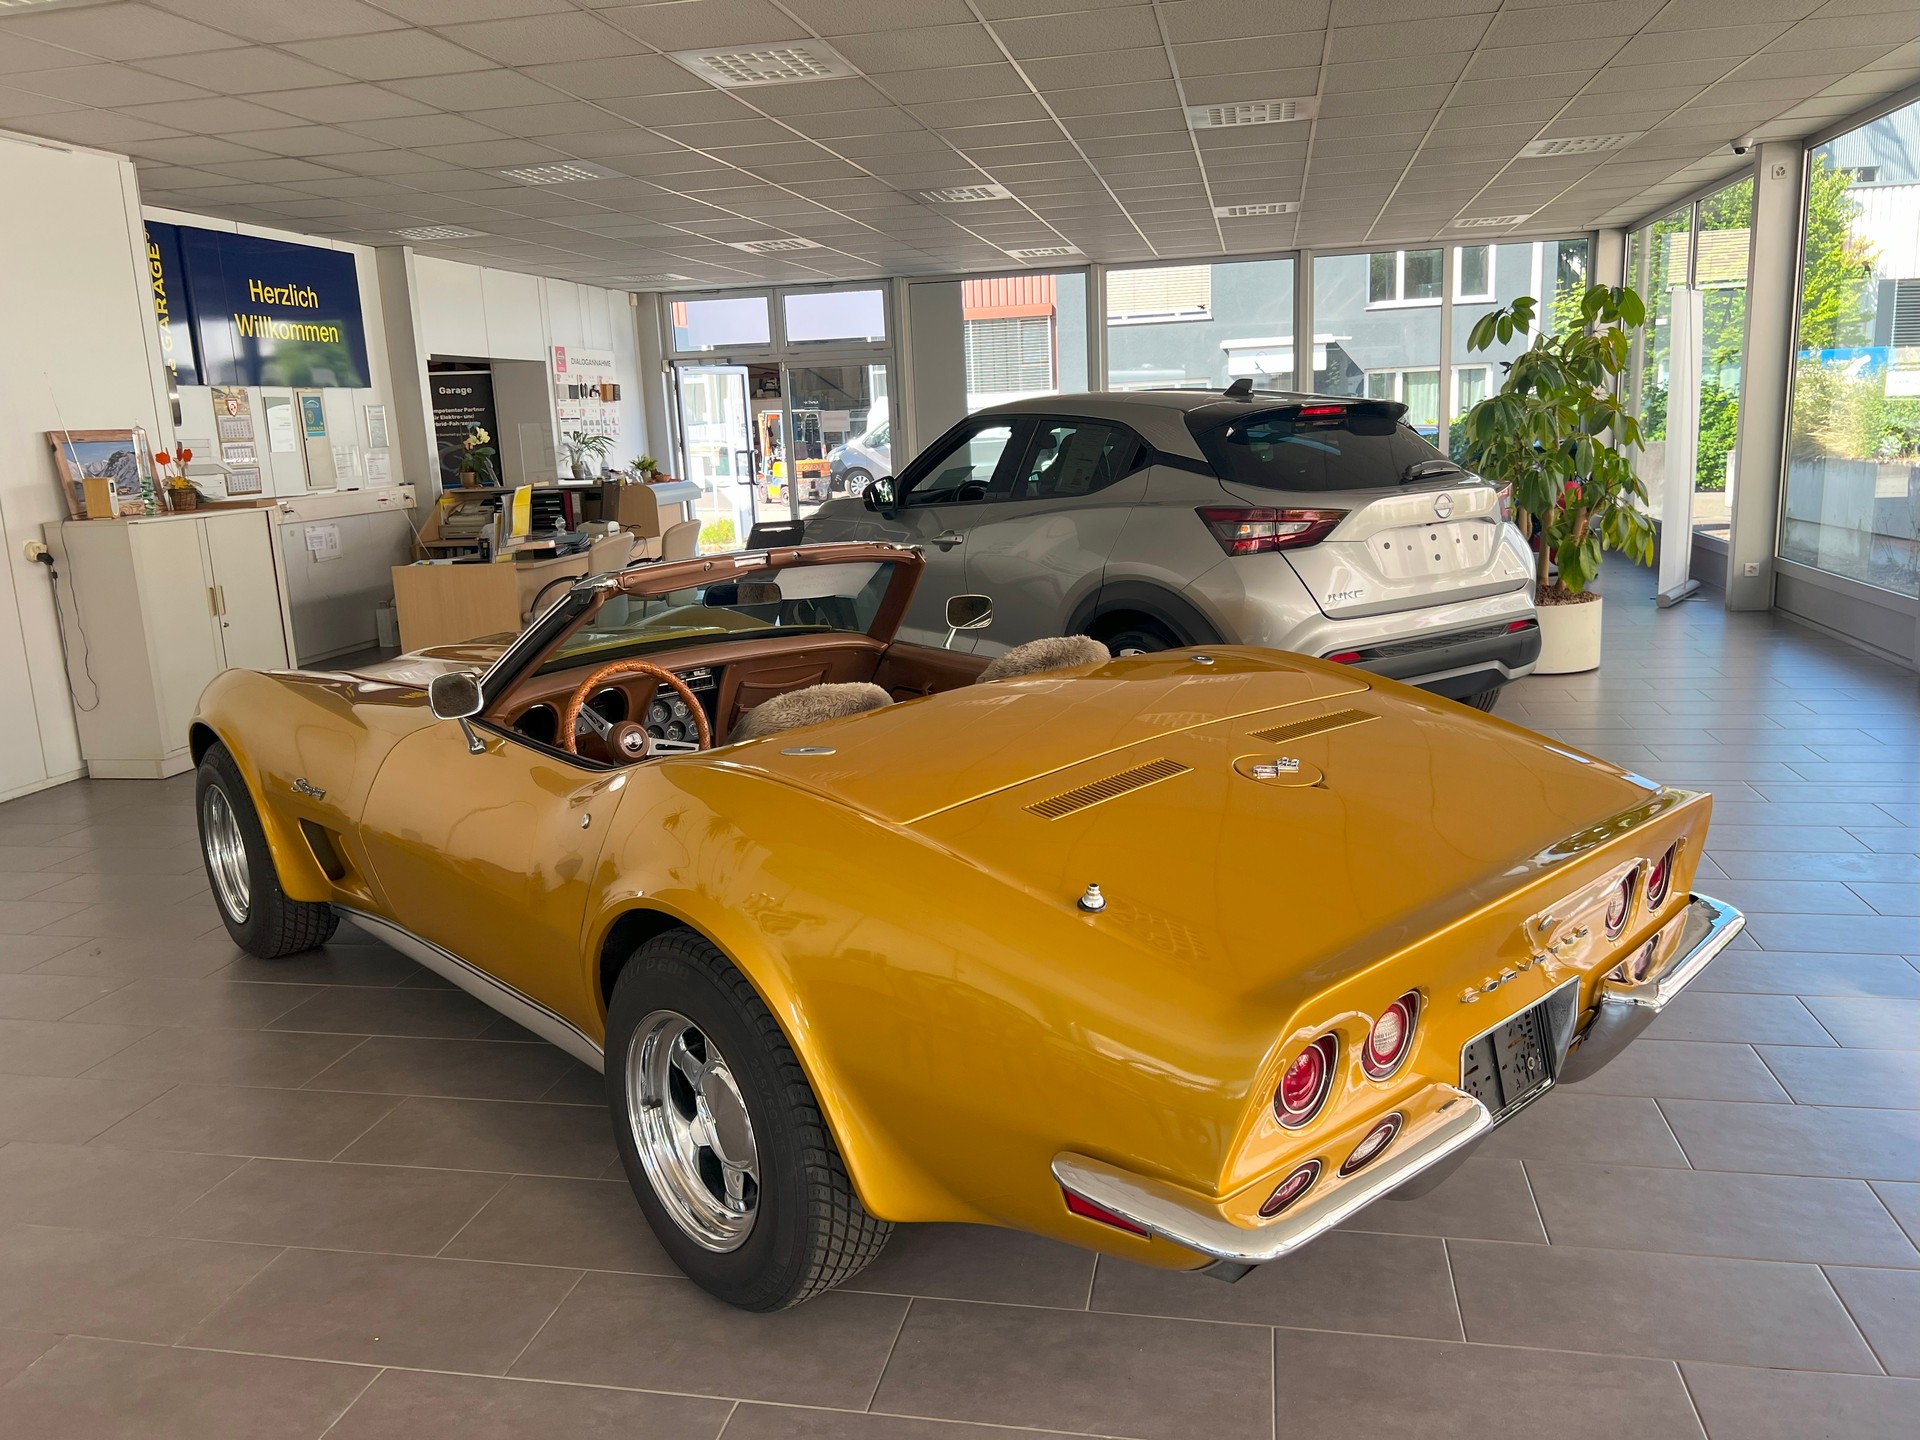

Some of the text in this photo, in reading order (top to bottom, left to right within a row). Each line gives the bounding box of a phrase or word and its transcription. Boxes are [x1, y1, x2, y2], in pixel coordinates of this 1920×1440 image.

[147, 241, 173, 352] GARAGE
[248, 278, 319, 308] Herzlich
[233, 313, 339, 343] Willkommen
[438, 386, 473, 396] Garage
